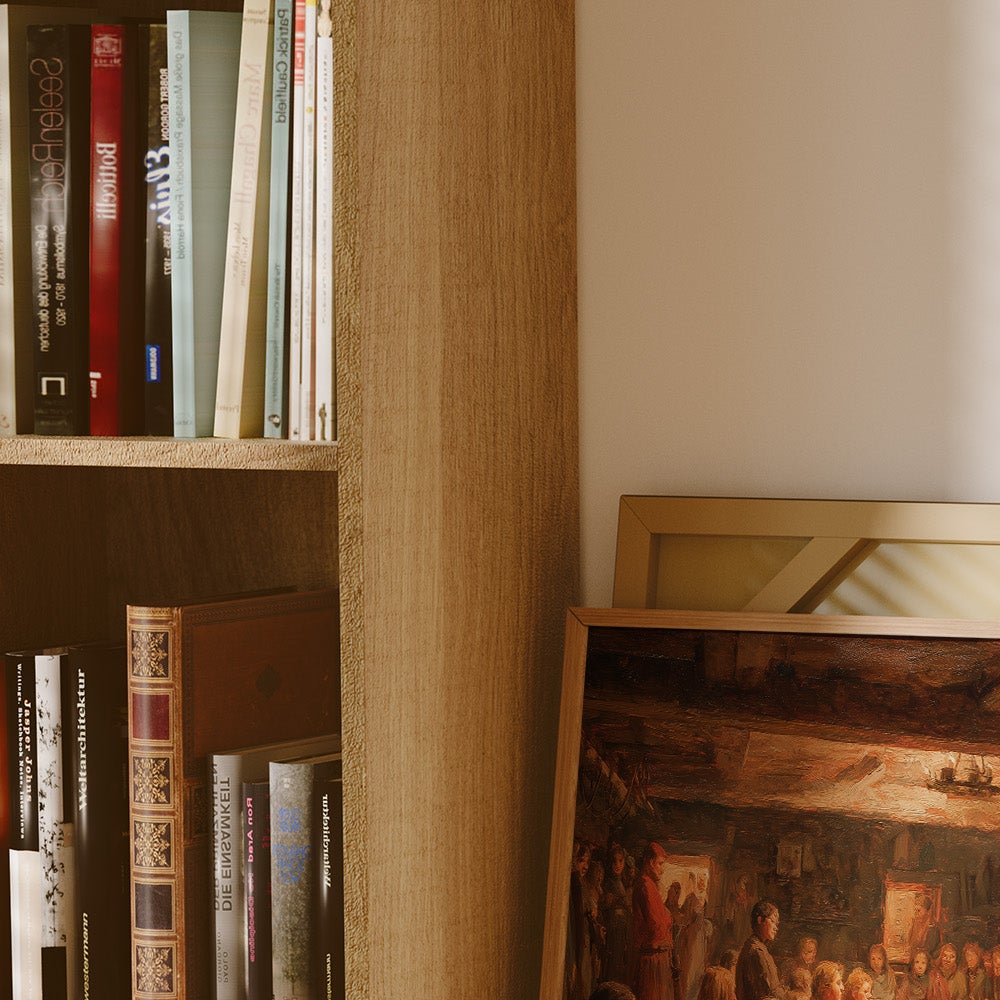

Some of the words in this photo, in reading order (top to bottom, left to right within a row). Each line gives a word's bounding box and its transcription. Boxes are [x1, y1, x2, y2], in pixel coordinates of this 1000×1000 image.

[23, 699, 33, 752] Jasper
[77, 669, 88, 811] Weltarchitektur
[25, 756, 34, 803] Johns
